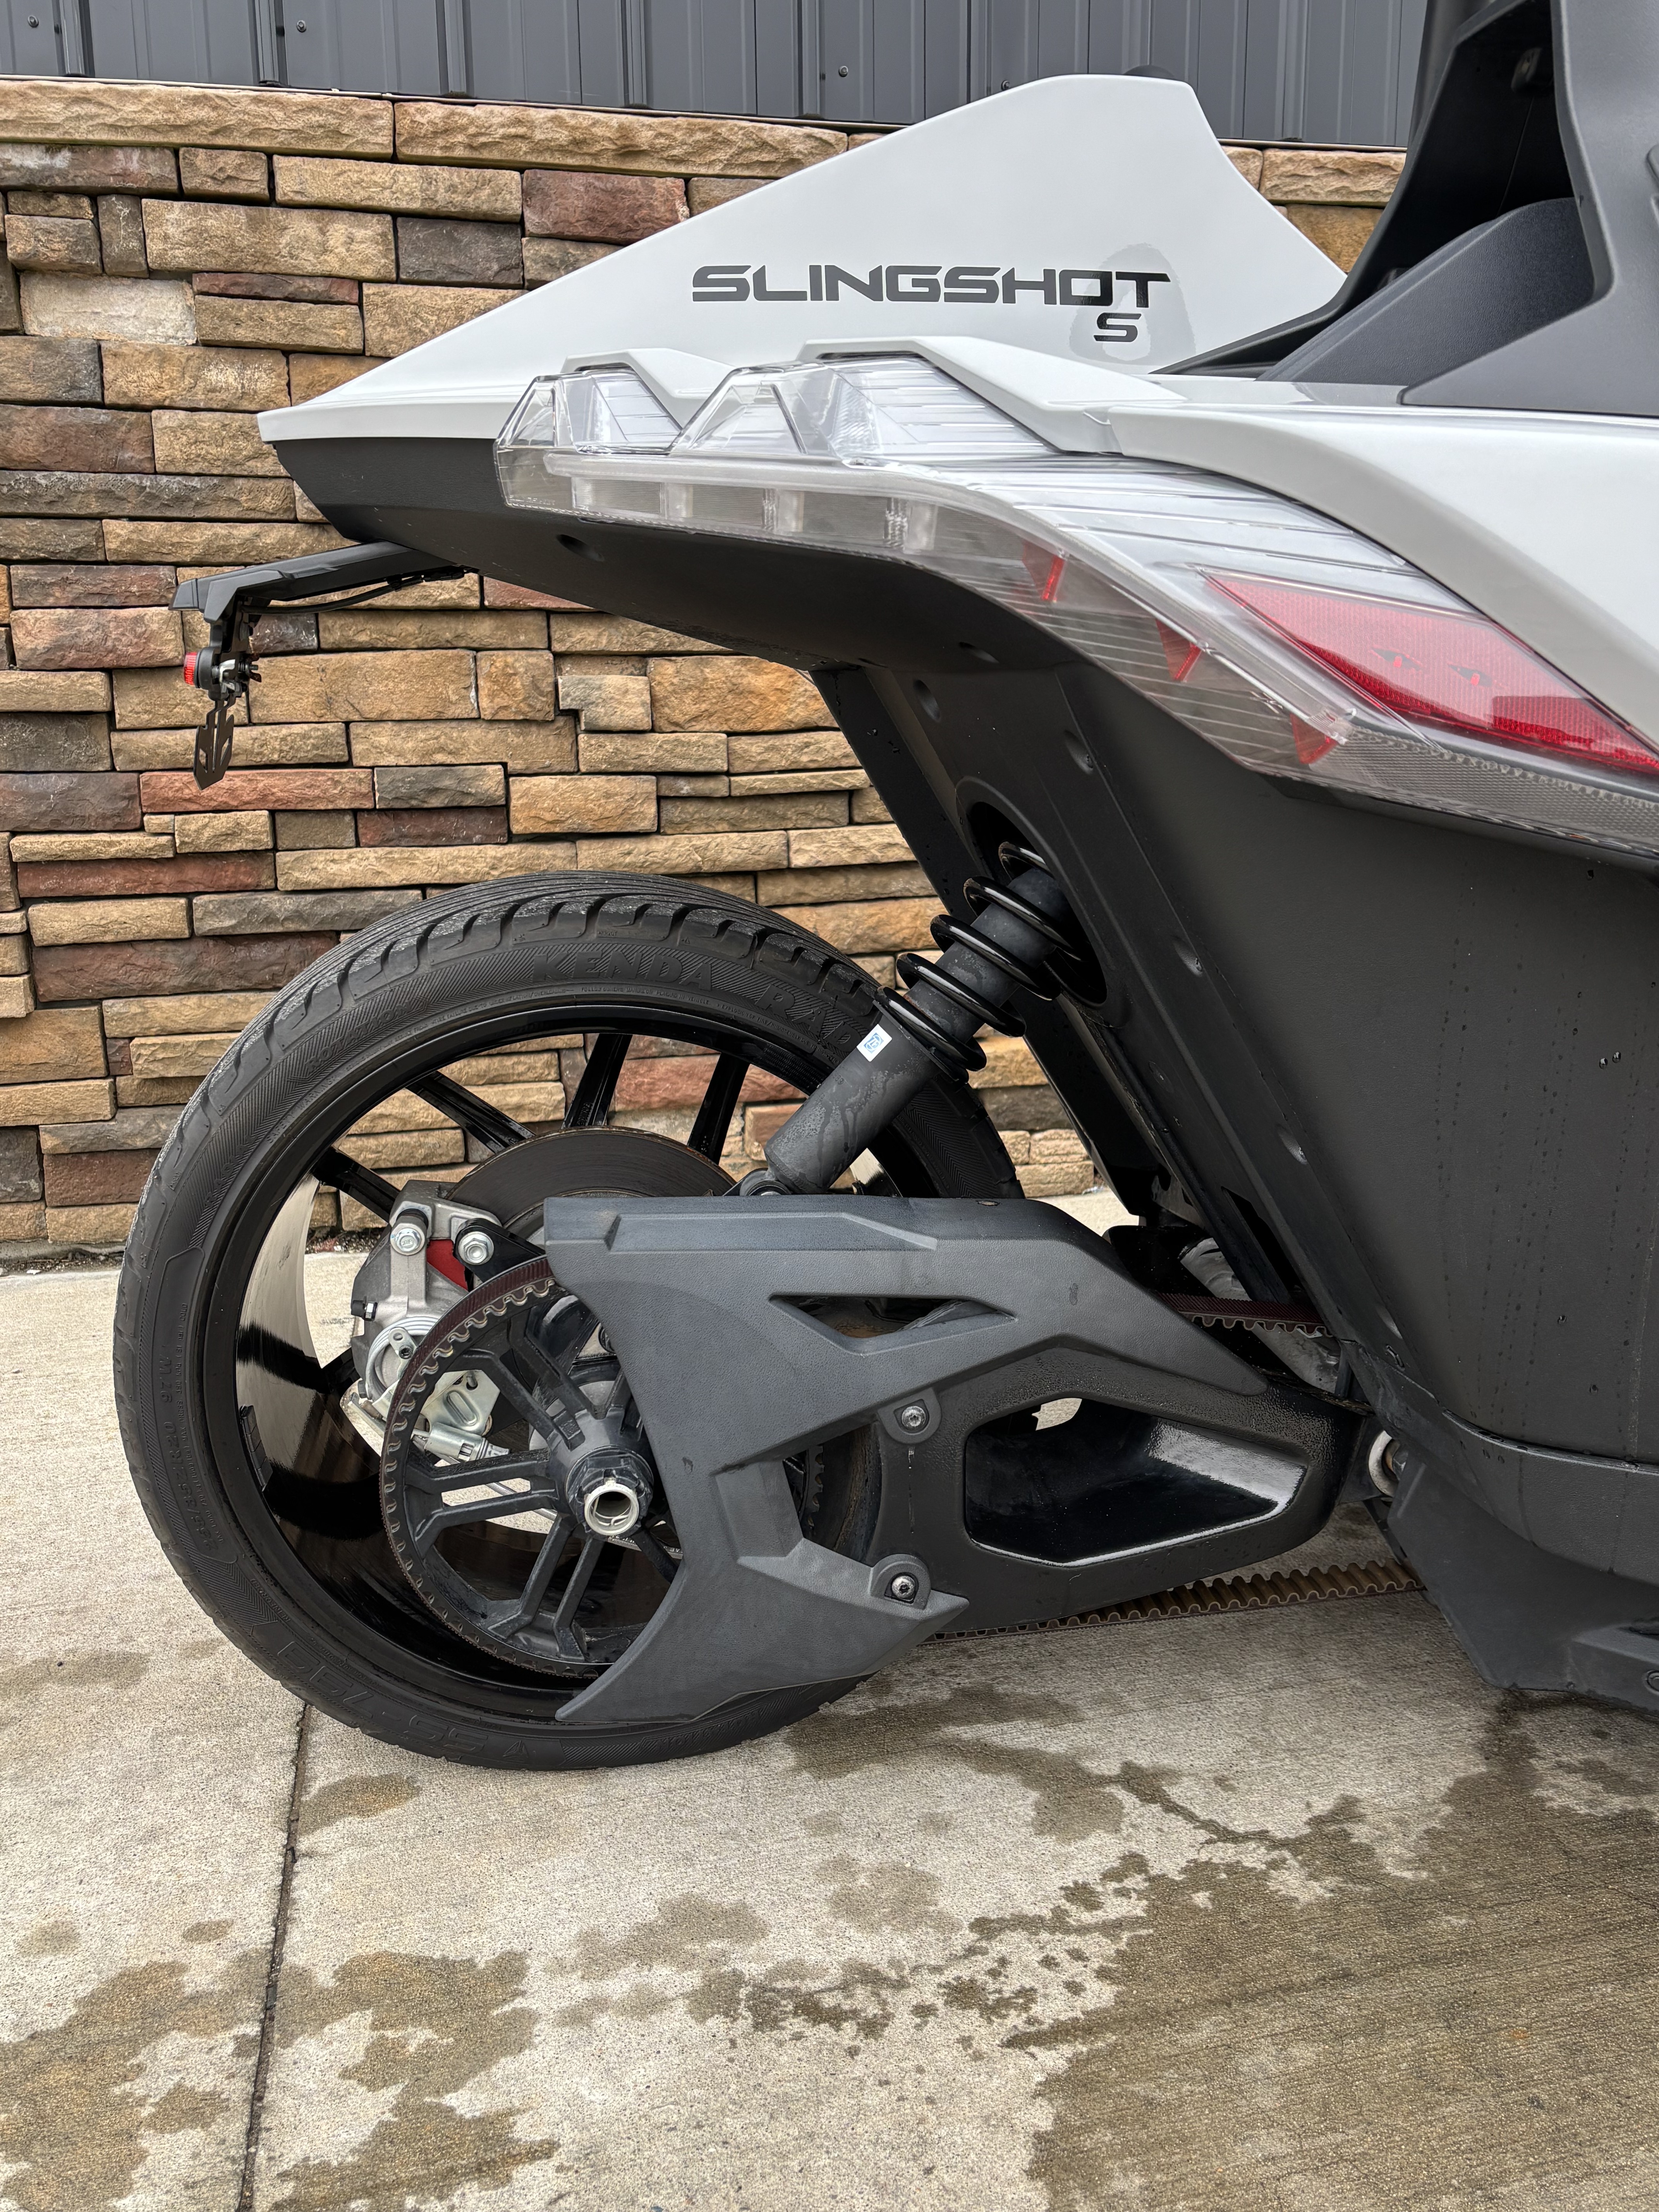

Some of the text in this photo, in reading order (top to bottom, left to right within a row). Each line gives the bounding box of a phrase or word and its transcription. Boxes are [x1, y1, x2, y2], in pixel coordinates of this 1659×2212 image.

[692, 264, 1171, 309] SLINGSHOT
[1093, 312, 1142, 343] S
[532, 951, 712, 992] KENDA
[304, 1000, 414, 1073] ROTATION
[264, 1112, 295, 1145] SAFETY
[202, 1129, 258, 1209] RADIAL
[178, 1302, 188, 1321] COLD
[179, 1426, 188, 1441] MAX
[162, 1420, 219, 1553] 255/35ZR20
[204, 1509, 218, 1528] LOAD
[214, 1529, 226, 1544] MAX
[249, 1577, 292, 1624] REINFORCED
[276, 1640, 488, 1753] SS-799
